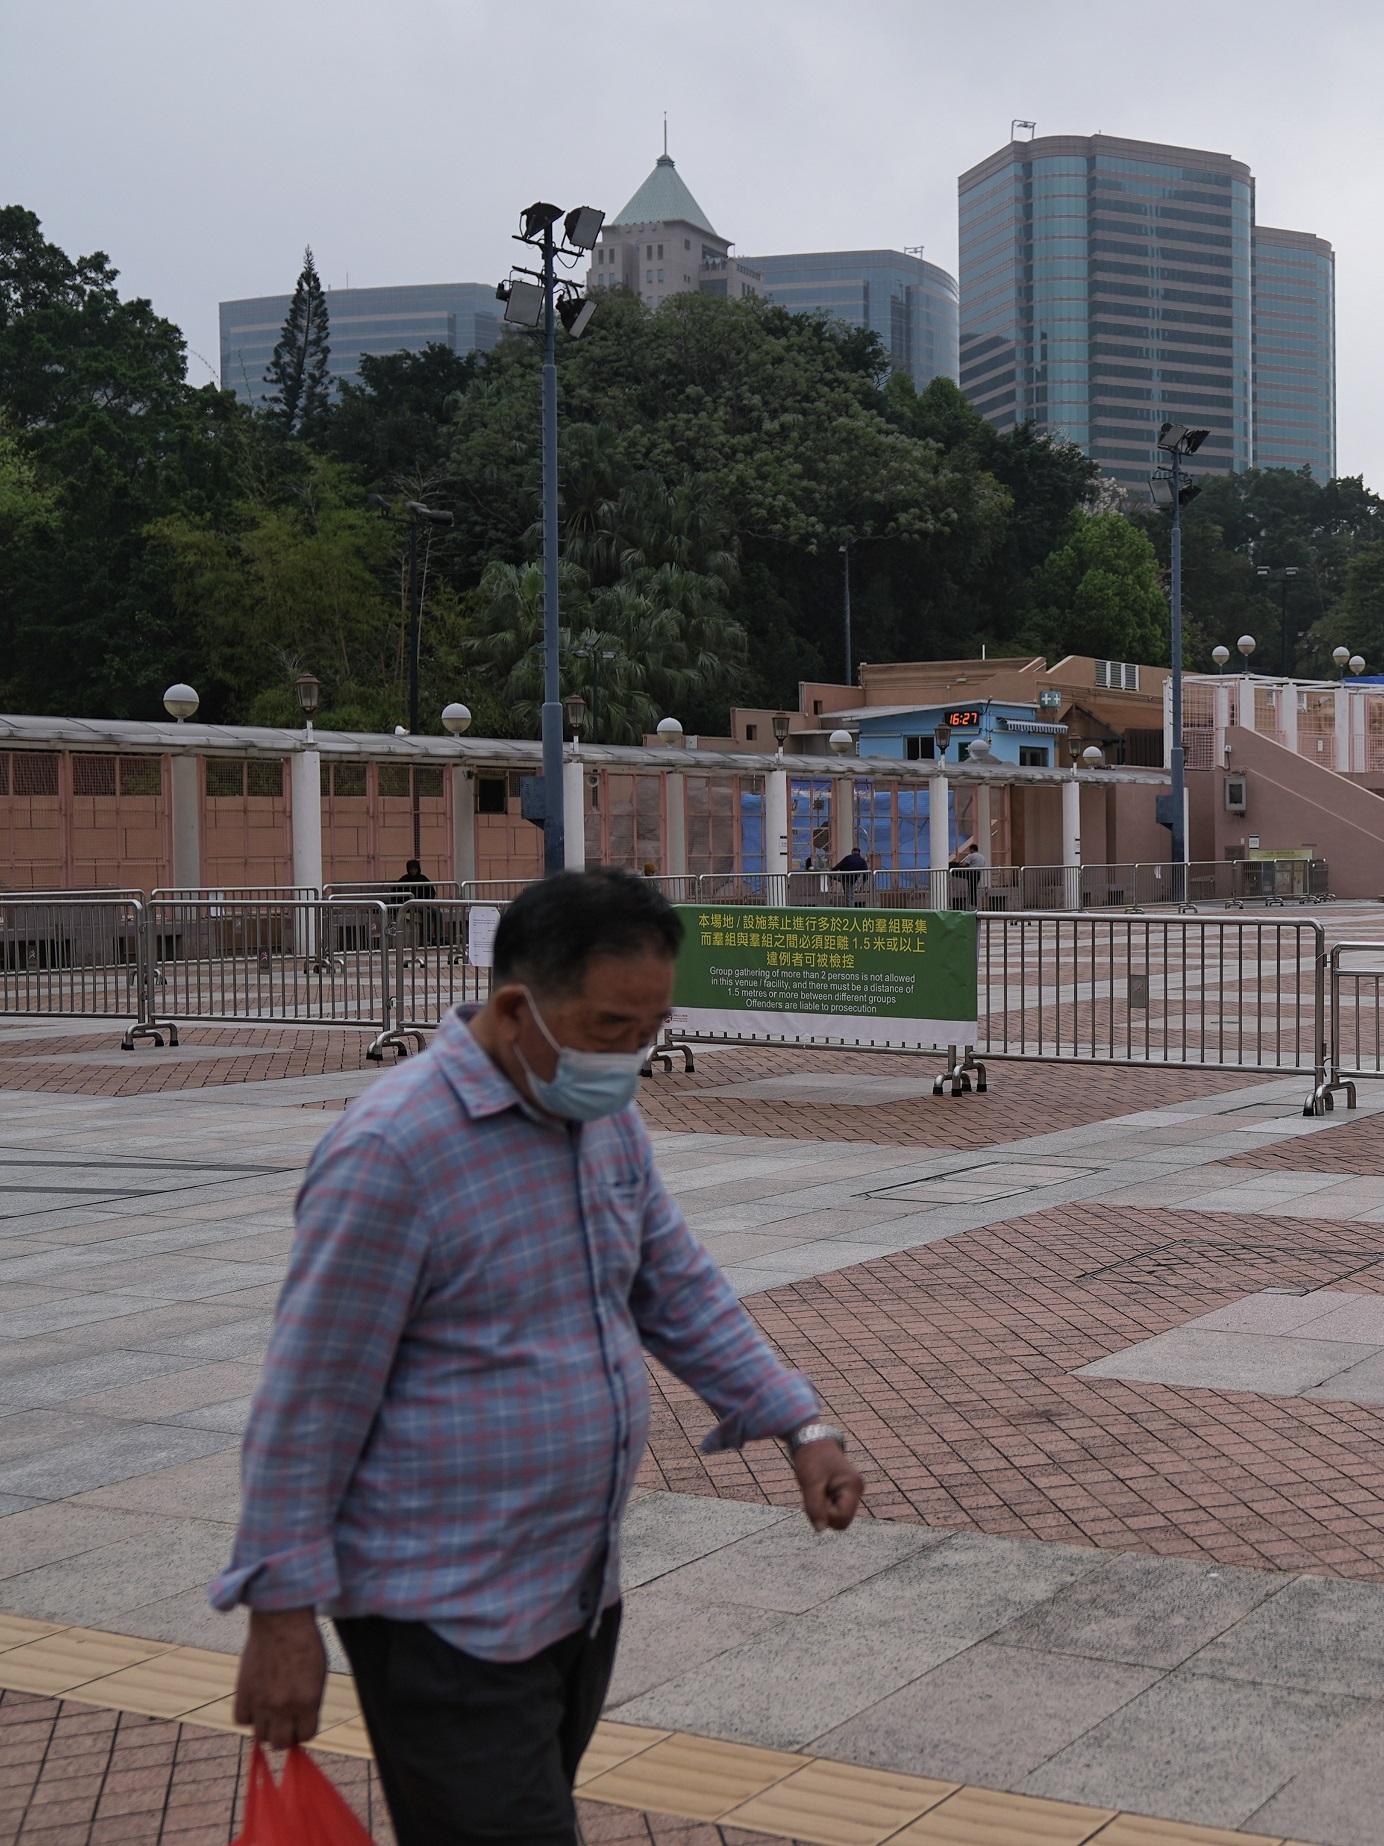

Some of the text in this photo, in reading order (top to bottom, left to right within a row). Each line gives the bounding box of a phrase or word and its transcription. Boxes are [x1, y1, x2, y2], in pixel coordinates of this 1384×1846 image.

[950, 712, 978, 725] 16:27
[852, 937, 870, 950] 1.5
[873, 936, 926, 953] 米或以上
[766, 951, 854, 968] 違例者可被檢控
[710, 966, 733, 977] Group
[734, 968, 770, 979] gathering
[772, 969, 779, 977] of
[803, 970, 820, 979] than
[821, 971, 826, 979] 2
[828, 973, 859, 982] persons
[861, 972, 868, 980] is
[870, 974, 882, 982] not
[884, 974, 916, 983] allowed
[711, 977, 718, 985] in
[720, 978, 733, 986] this
[764, 978, 791, 989] facility,
[792, 981, 807, 989] and
[809, 982, 828, 990] there
[830, 983, 850, 991] must
[852, 983, 862, 991] be
[870, 984, 903, 993] distance
[905, 985, 914, 994] of
[728, 988, 740, 996] 1.5
[801, 991, 833, 1000] between
[834, 993, 867, 1002] different
[868, 995, 897, 1004] groups
[746, 999, 782, 1008] Offenders
[800, 1001, 820, 1010] liable
[830, 1004, 877, 1013] prosecution
